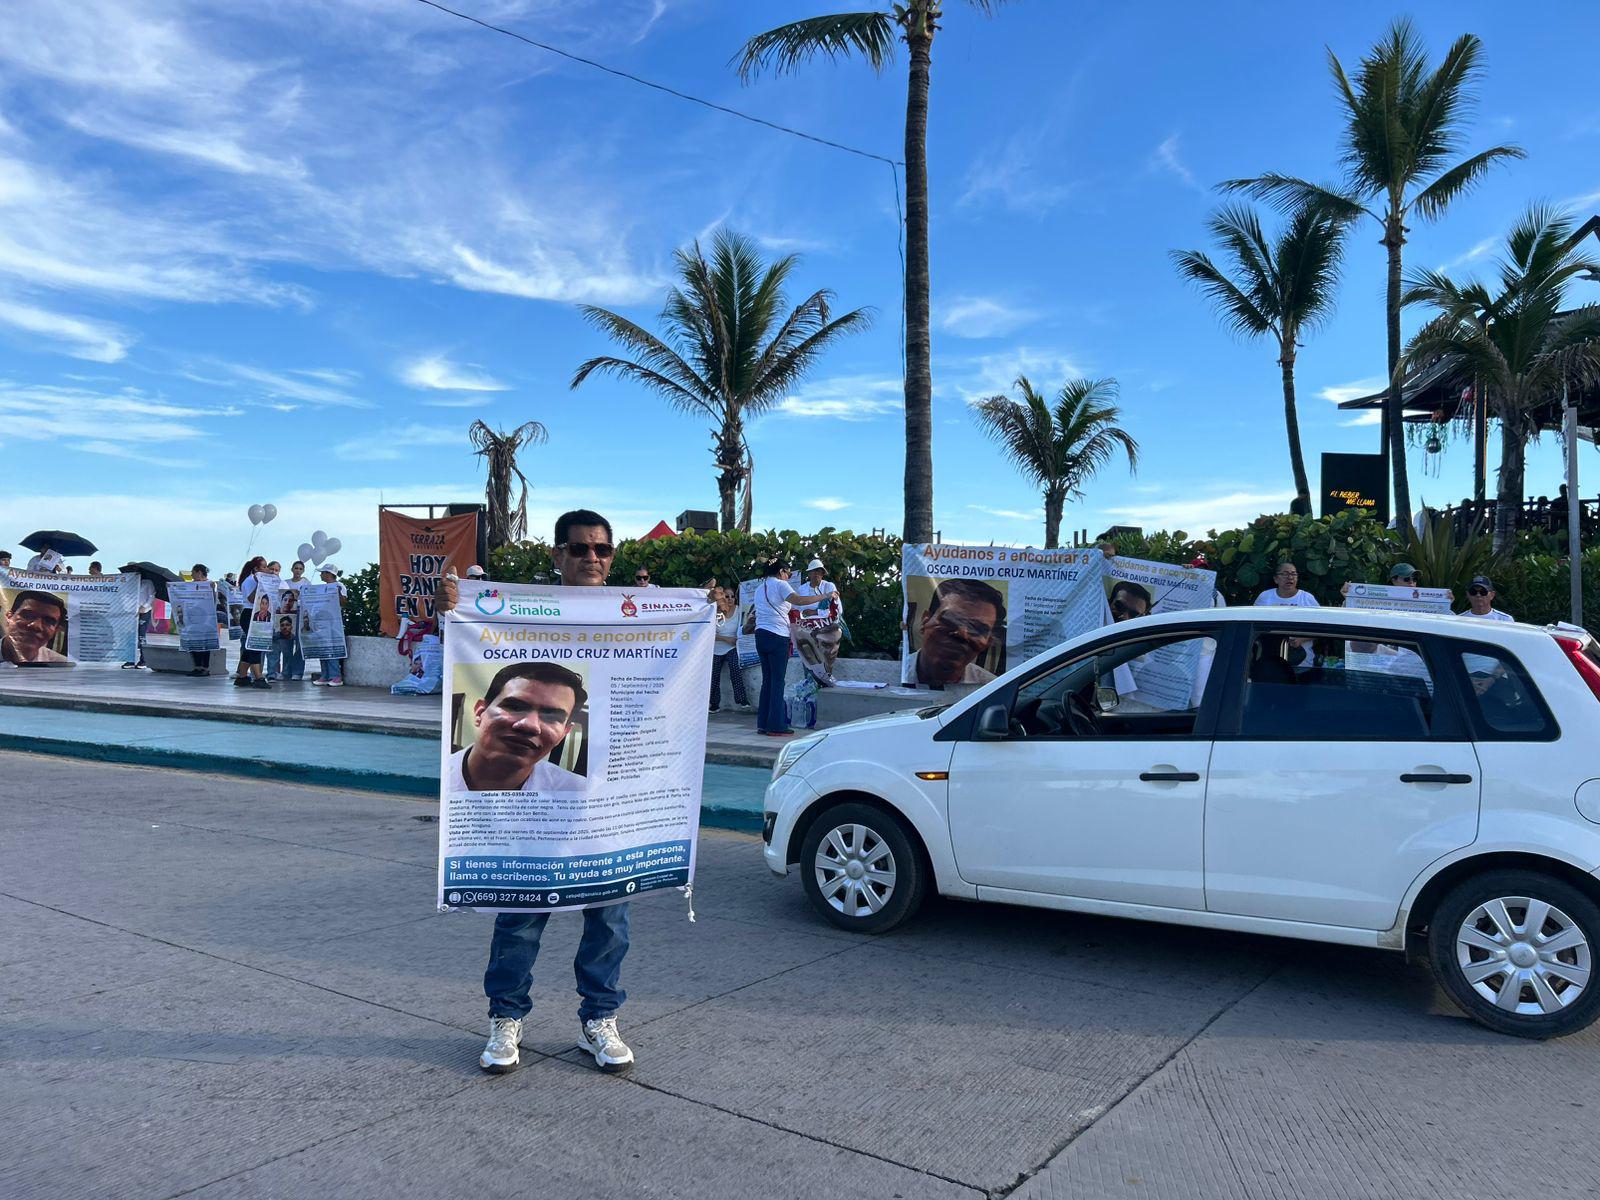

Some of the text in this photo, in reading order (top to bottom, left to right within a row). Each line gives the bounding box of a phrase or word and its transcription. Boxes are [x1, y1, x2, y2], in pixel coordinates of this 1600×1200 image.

[410, 534, 446, 545] TERRAZA
[924, 544, 1089, 564] Ayúdanos a encontrar a
[410, 554, 446, 574] HOY
[927, 564, 1078, 581] OSCAR DAVID CRUZ MARTÍNEZ
[36, 582, 58, 590] DAVID
[1112, 570, 1128, 579] OSCAR
[1130, 573, 1148, 582] DAVID
[1150, 577, 1166, 586] CRUZ
[395, 595, 418, 616] EN
[510, 604, 560, 616] Sinaloa
[480, 627, 690, 645] Ayúdanos a encontrar a
[483, 646, 678, 660] OSCAR DAVID CRUZ MARTÍNEZ
[450, 860, 460, 870] Si
[466, 860, 497, 869] tienes
[502, 860, 564, 870] información
[569, 857, 612, 868] referente
[626, 850, 644, 860] esta
[648, 844, 686, 857] persona,
[450, 872, 478, 880] llama
[491, 872, 550, 882] escribenos.
[554, 872, 566, 880] Tu
[569, 870, 599, 881] ayuda
[602, 868, 612, 876] es
[615, 864, 634, 874] muy
[636, 855, 685, 869] importante.
[474, 892, 498, 902] (669)
[500, 893, 516, 902] 327
[519, 893, 542, 902] 8424
